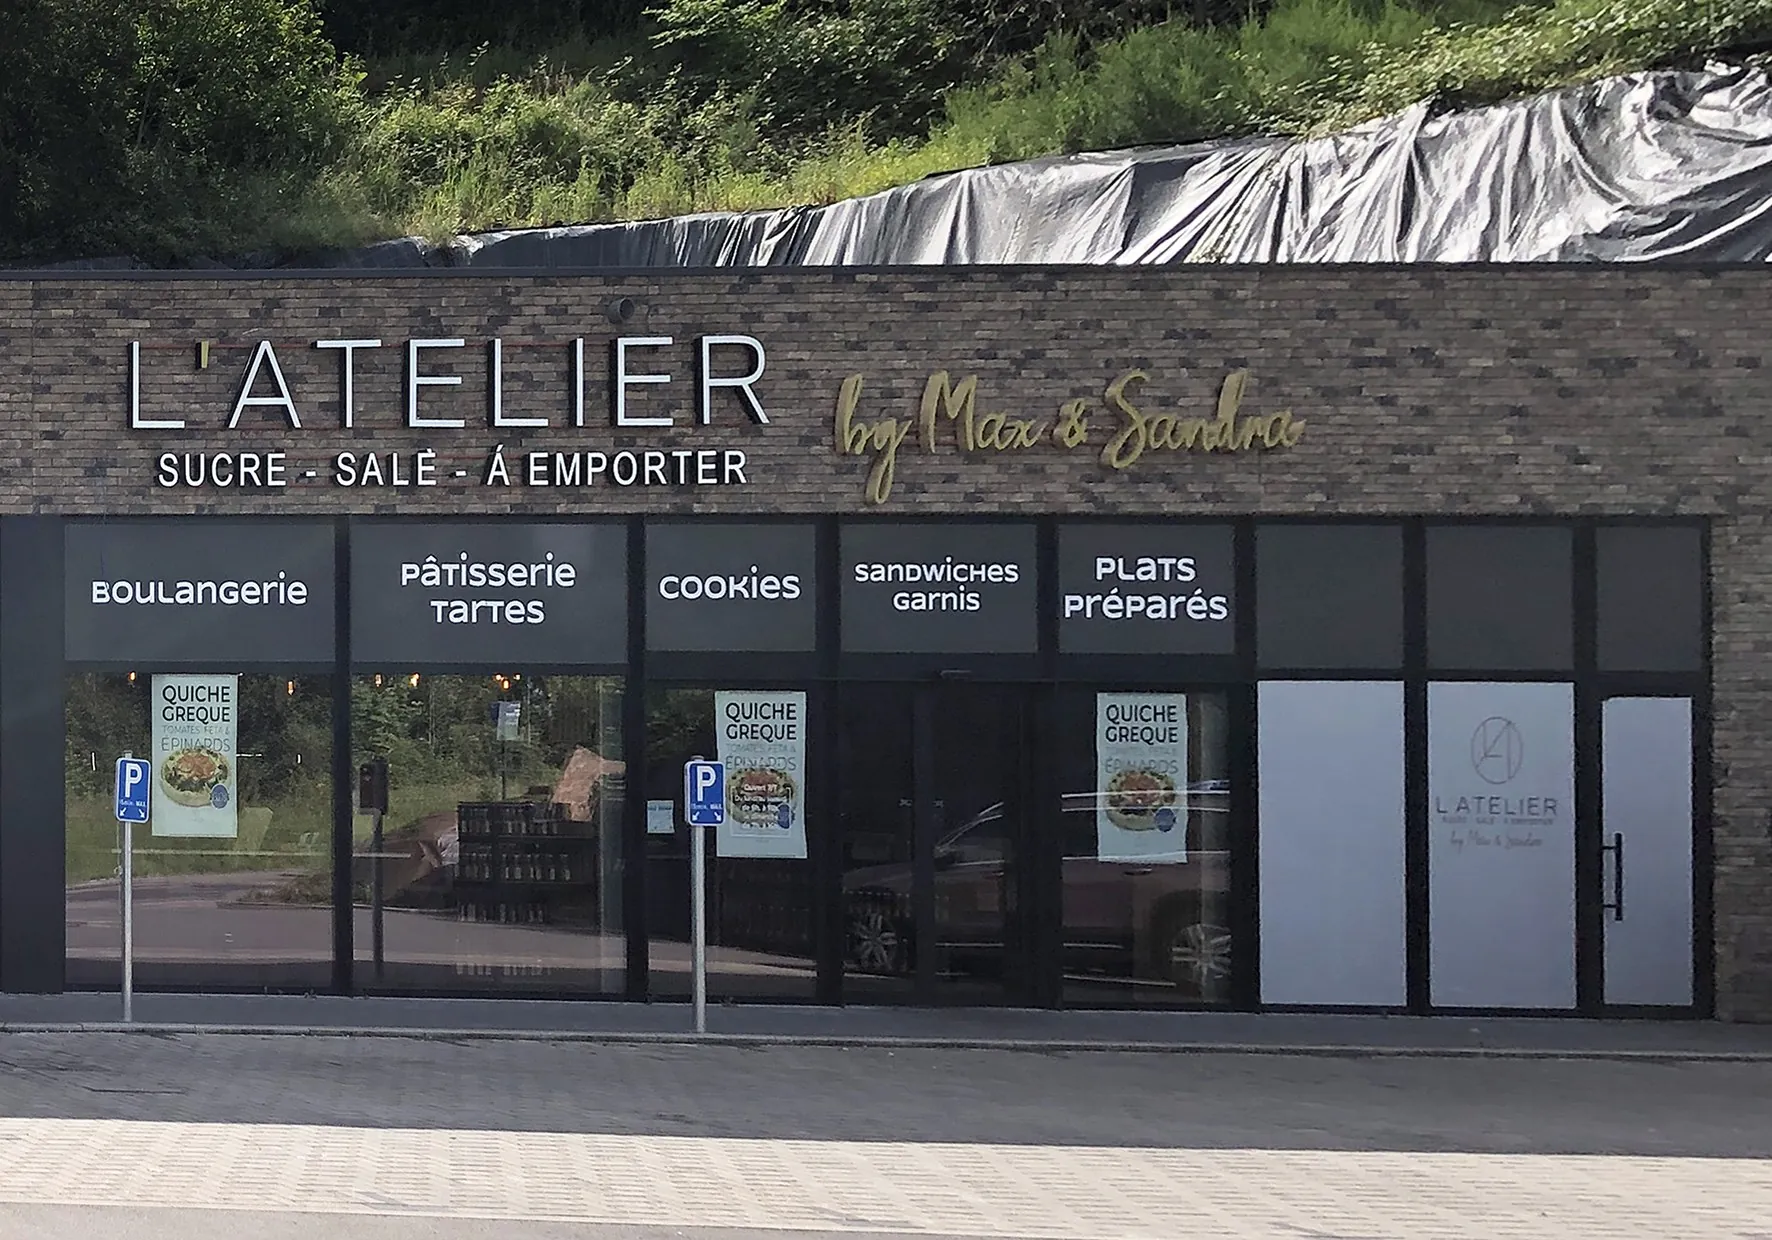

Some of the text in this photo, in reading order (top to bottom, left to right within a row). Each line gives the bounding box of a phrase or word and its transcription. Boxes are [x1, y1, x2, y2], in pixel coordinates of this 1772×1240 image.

[130, 335, 770, 430] L'ATELIER
[835, 367, 1305, 504] by Max & Sandra
[157, 452, 287, 487] SUCRE
[529, 450, 748, 487] EMPORTER
[162, 685, 231, 705] QUICHE
[162, 706, 231, 725] GREQUE
[725, 702, 797, 722] QUICHE
[1106, 704, 1178, 724] QUICHE
[726, 724, 797, 743] GREQUE
[1105, 726, 1178, 745] GREQUE
[1105, 756, 1179, 774] ÉPNARDS
[125, 763, 142, 798] P
[697, 765, 717, 801] P
[1436, 796, 1558, 817] LATELIER
